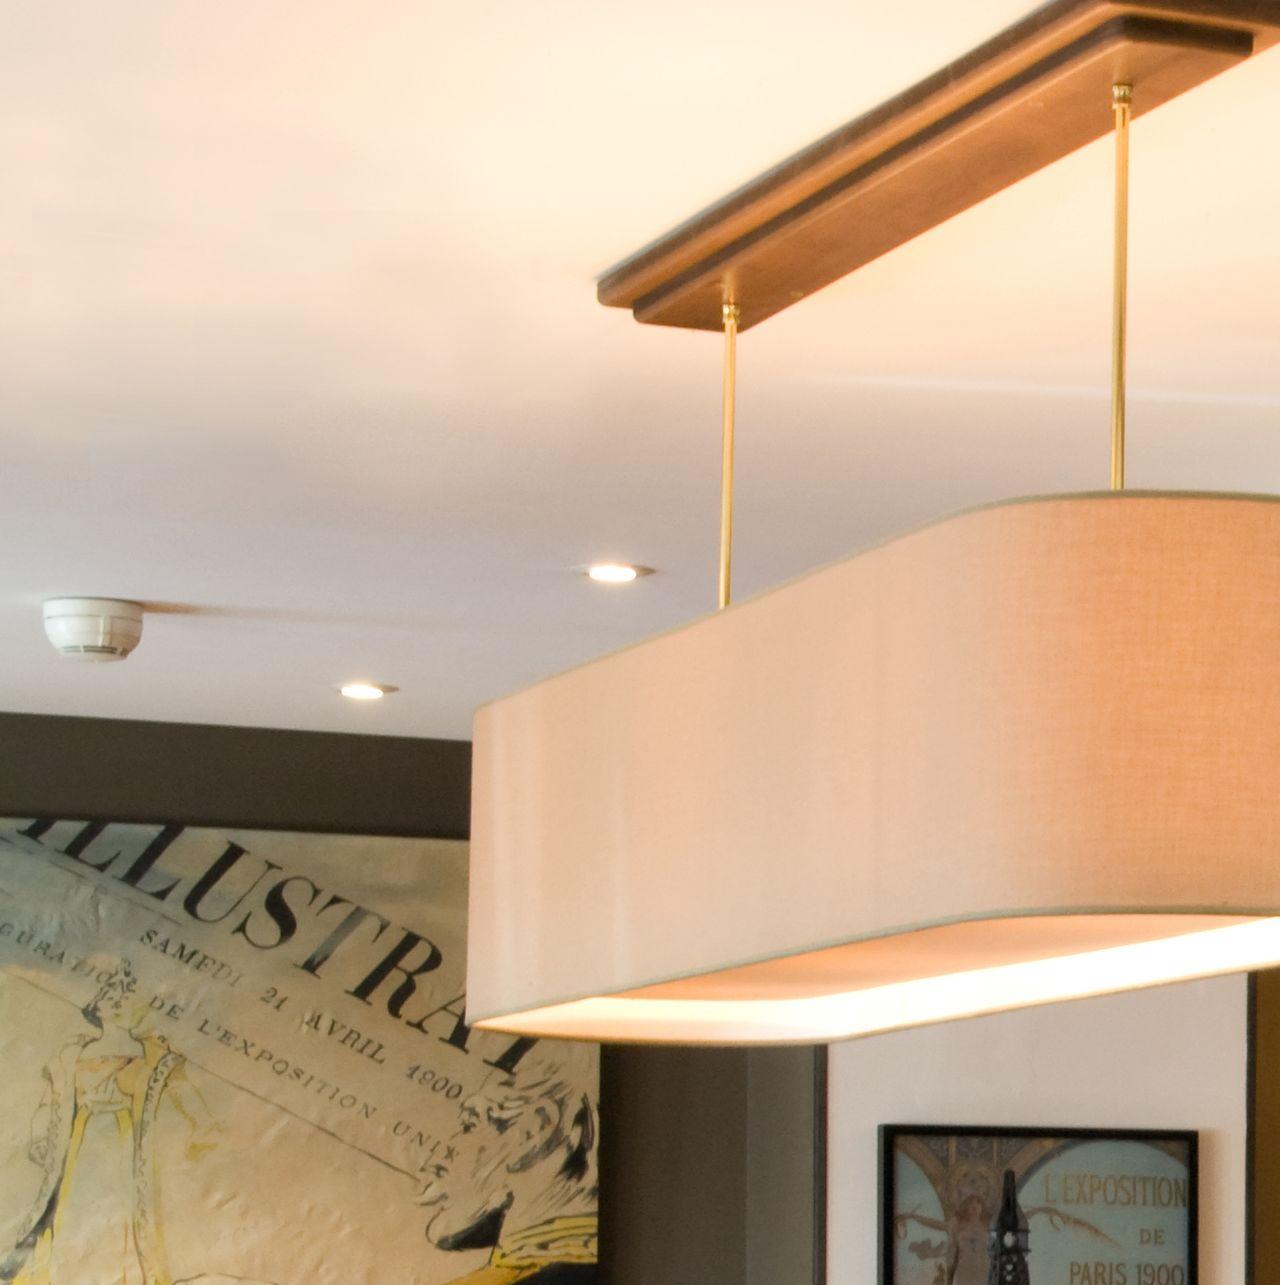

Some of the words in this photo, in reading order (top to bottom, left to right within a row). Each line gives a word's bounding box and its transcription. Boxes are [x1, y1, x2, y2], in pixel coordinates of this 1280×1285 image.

[139, 928, 243, 988] SAMEDI
[304, 1009, 387, 1065] AVRIL
[149, 995, 186, 1021] DE
[197, 1018, 378, 1120] L'EXPOSITION
[1139, 1228, 1166, 1246] DE
